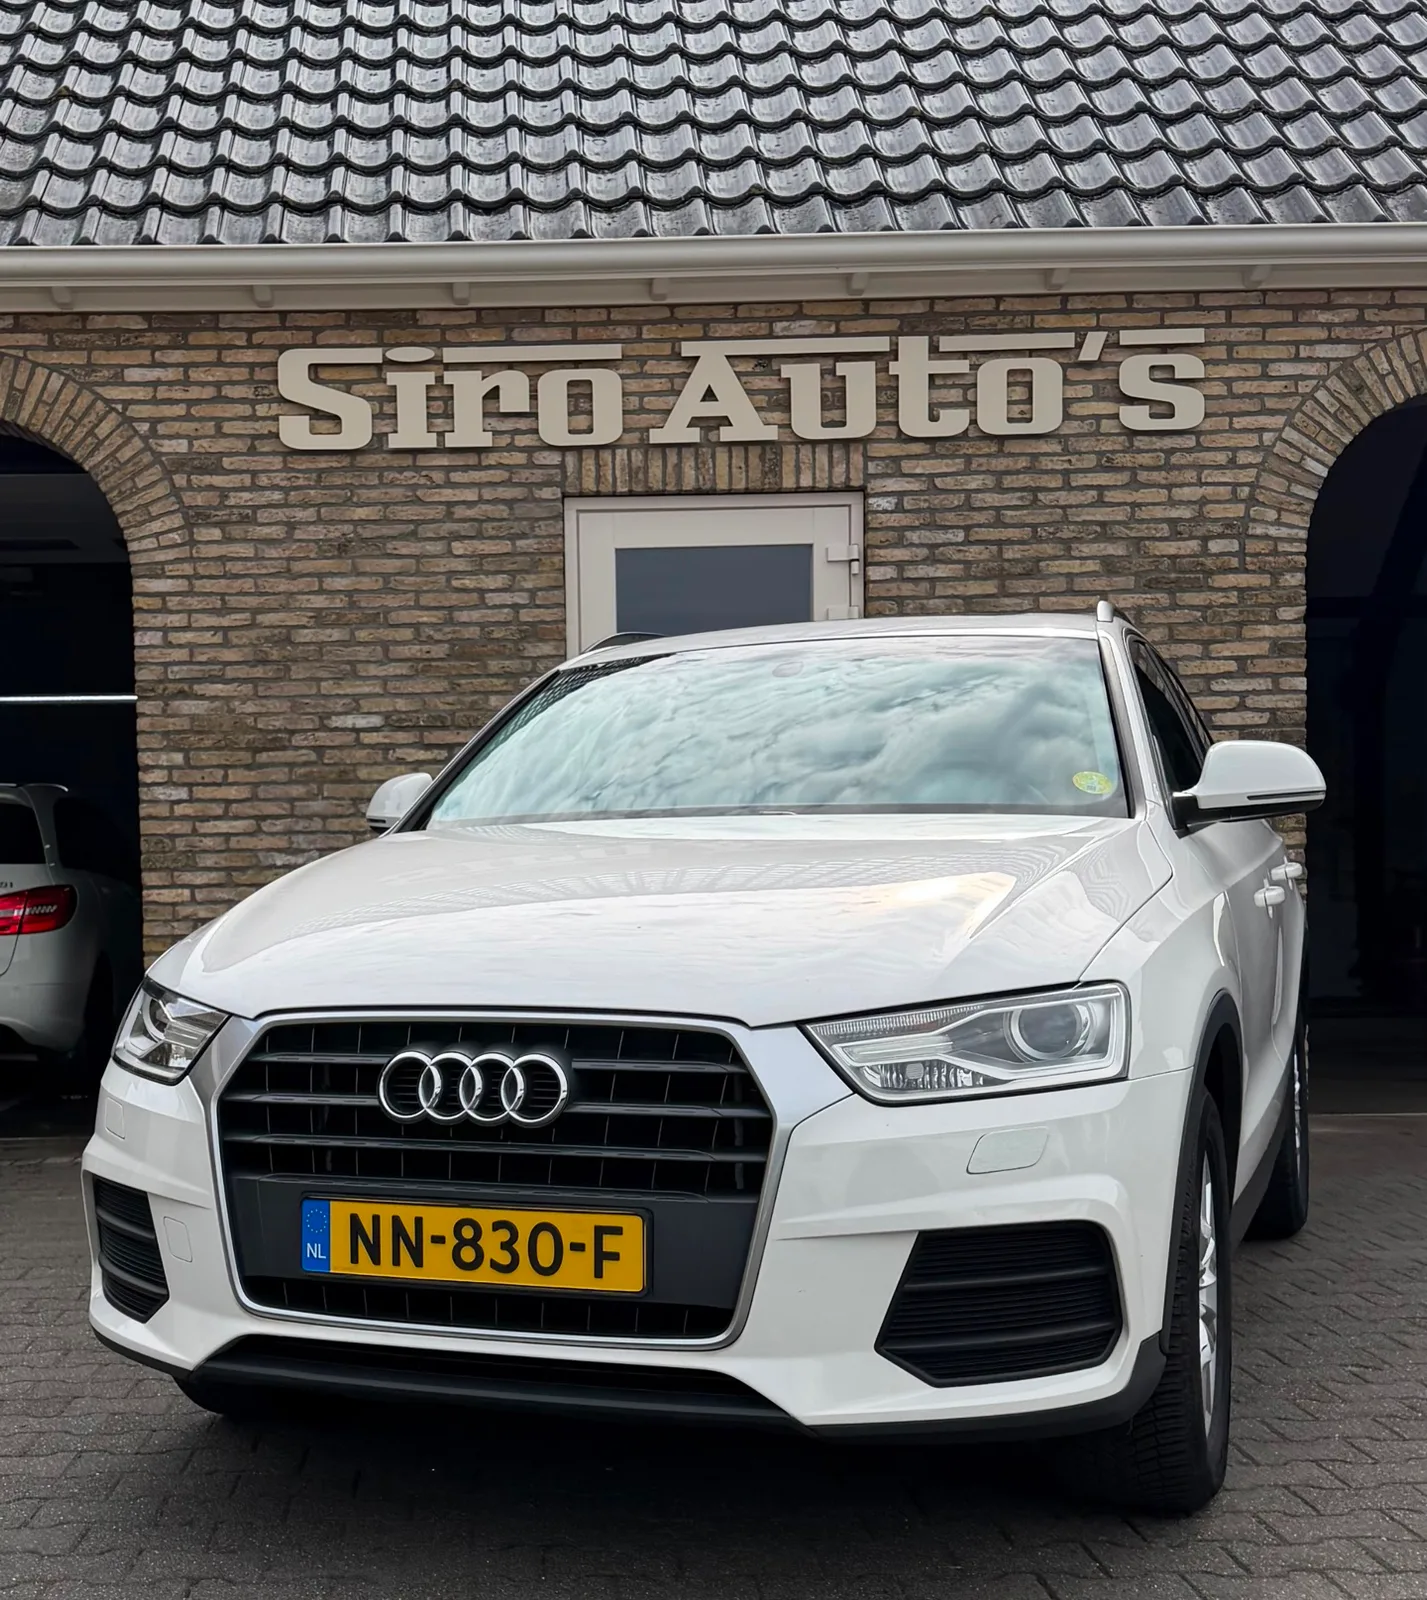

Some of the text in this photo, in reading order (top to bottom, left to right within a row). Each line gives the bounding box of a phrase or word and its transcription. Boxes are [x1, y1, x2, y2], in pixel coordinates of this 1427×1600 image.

[277, 328, 1206, 450] Siro Auto's
[306, 1242, 327, 1259] NL
[349, 1212, 624, 1279] NN-830-F
